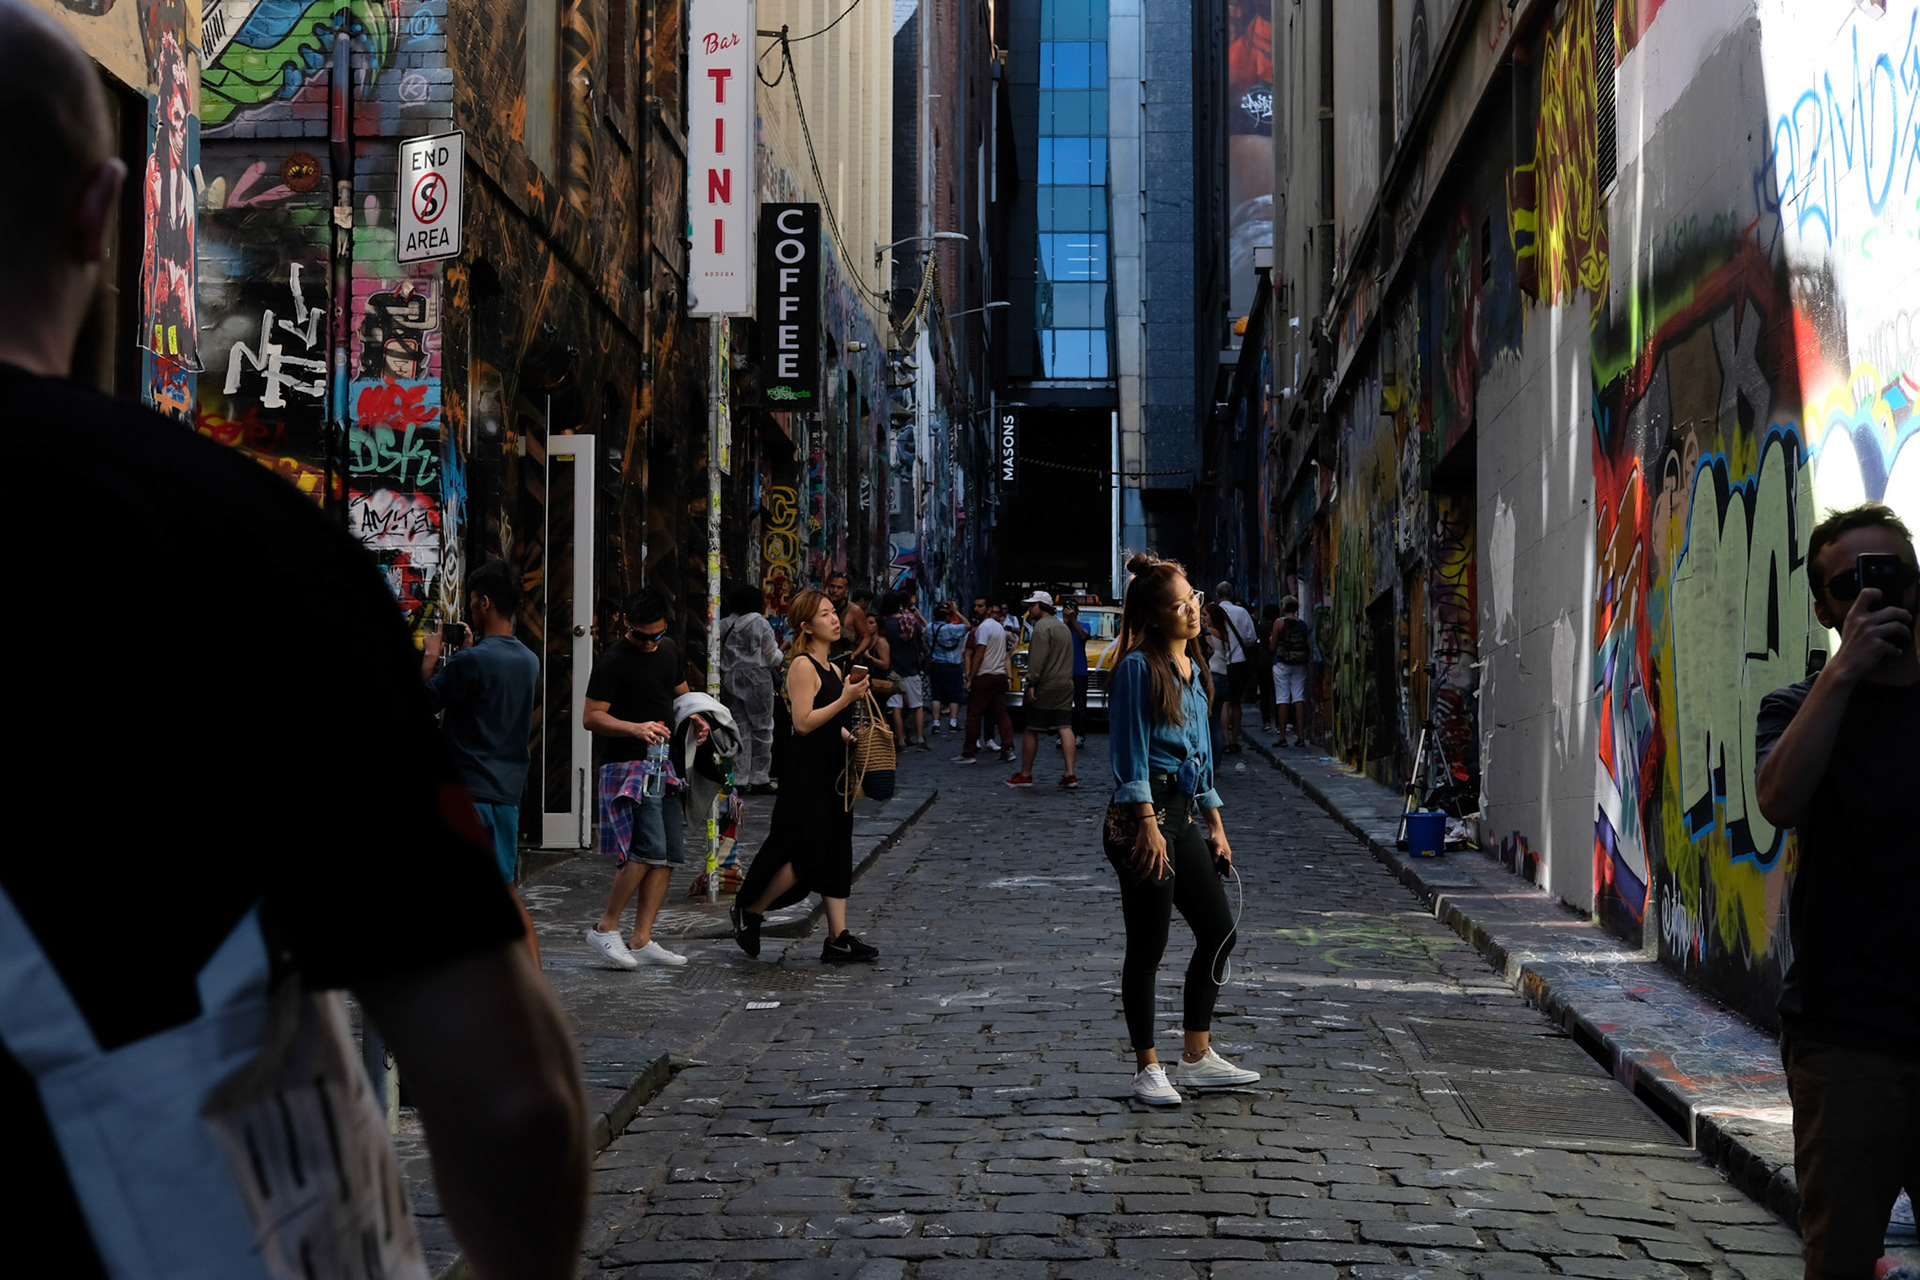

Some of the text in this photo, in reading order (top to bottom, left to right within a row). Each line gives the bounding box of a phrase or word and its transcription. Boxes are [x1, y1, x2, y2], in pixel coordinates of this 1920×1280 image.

[703, 32, 740, 55] Bar
[412, 147, 449, 171] END
[707, 69, 733, 254] TINI
[406, 227, 450, 252] AREA
[775, 209, 806, 378] COFFEE
[1002, 415, 1015, 481] MASONS
